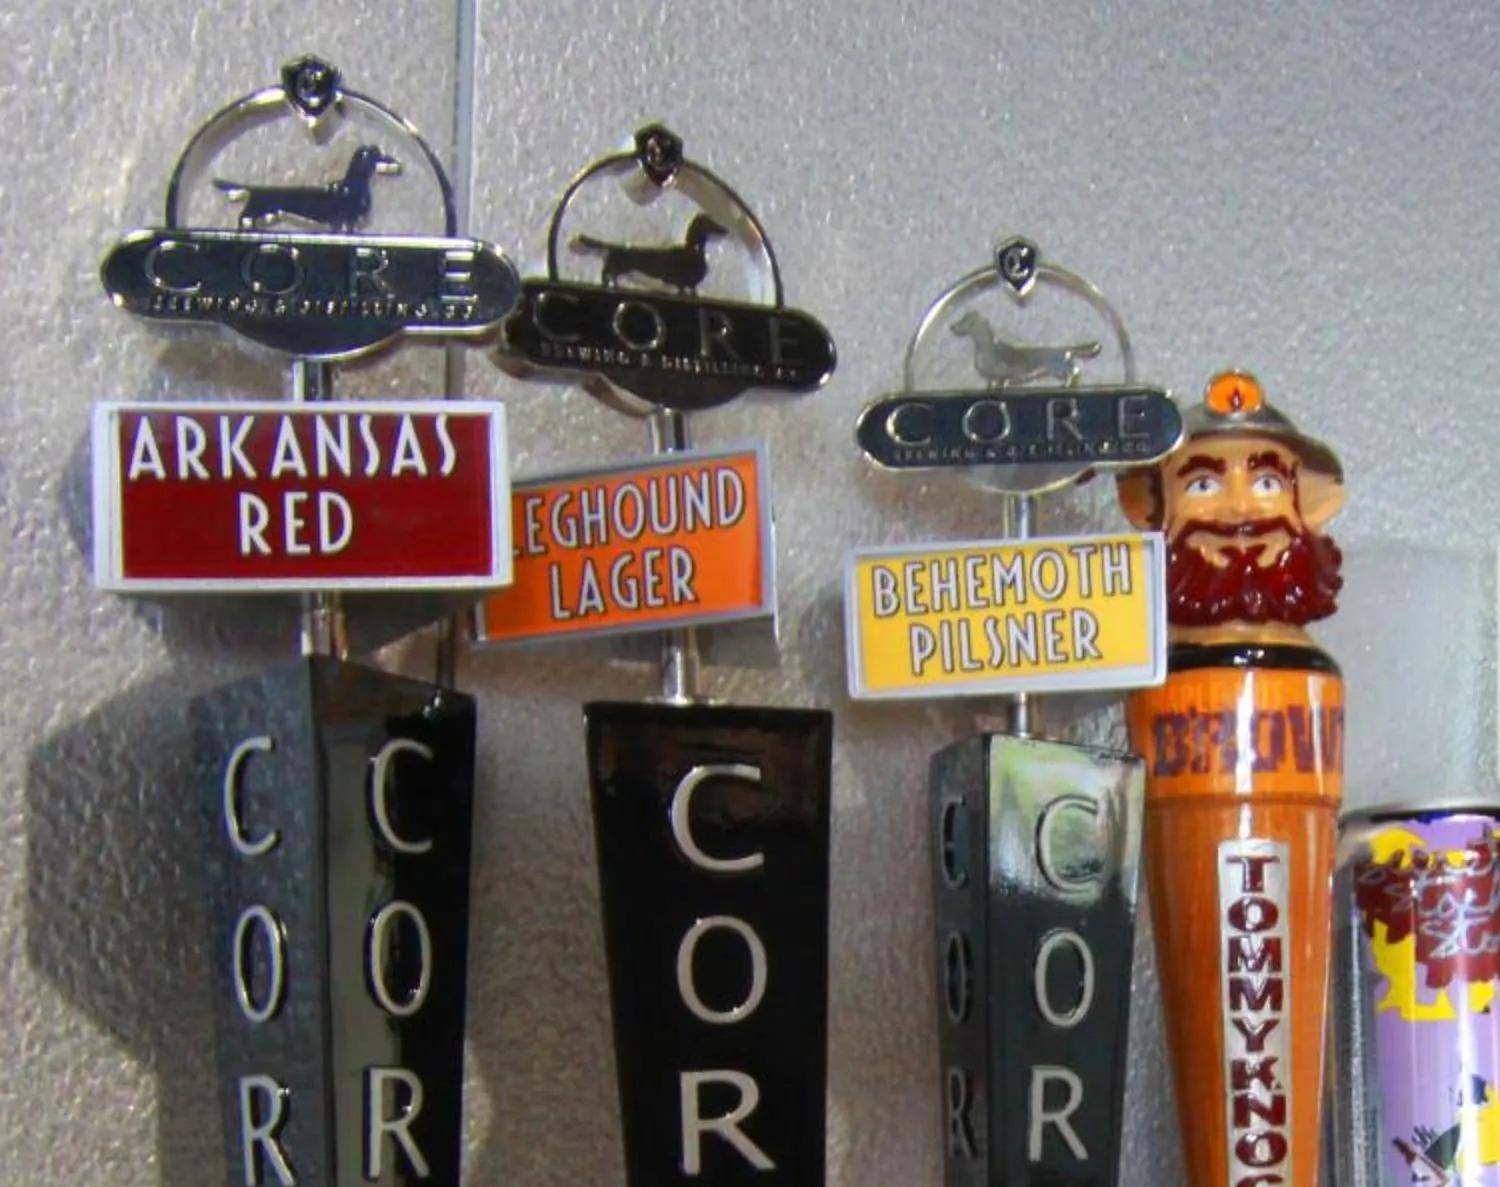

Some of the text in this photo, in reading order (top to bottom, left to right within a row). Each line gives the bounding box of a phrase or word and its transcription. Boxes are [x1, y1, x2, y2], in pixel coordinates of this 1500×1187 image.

[144, 240, 480, 301] CORE
[533, 291, 802, 368] CORE
[129, 413, 456, 480] ARKANSAS
[885, 394, 1151, 447] CORE
[239, 491, 354, 556] RED
[513, 466, 747, 558] EGHOUND
[549, 546, 699, 621] LAGER
[872, 542, 1134, 617] BEHEMOTH
[909, 608, 1103, 677] PILSNER
